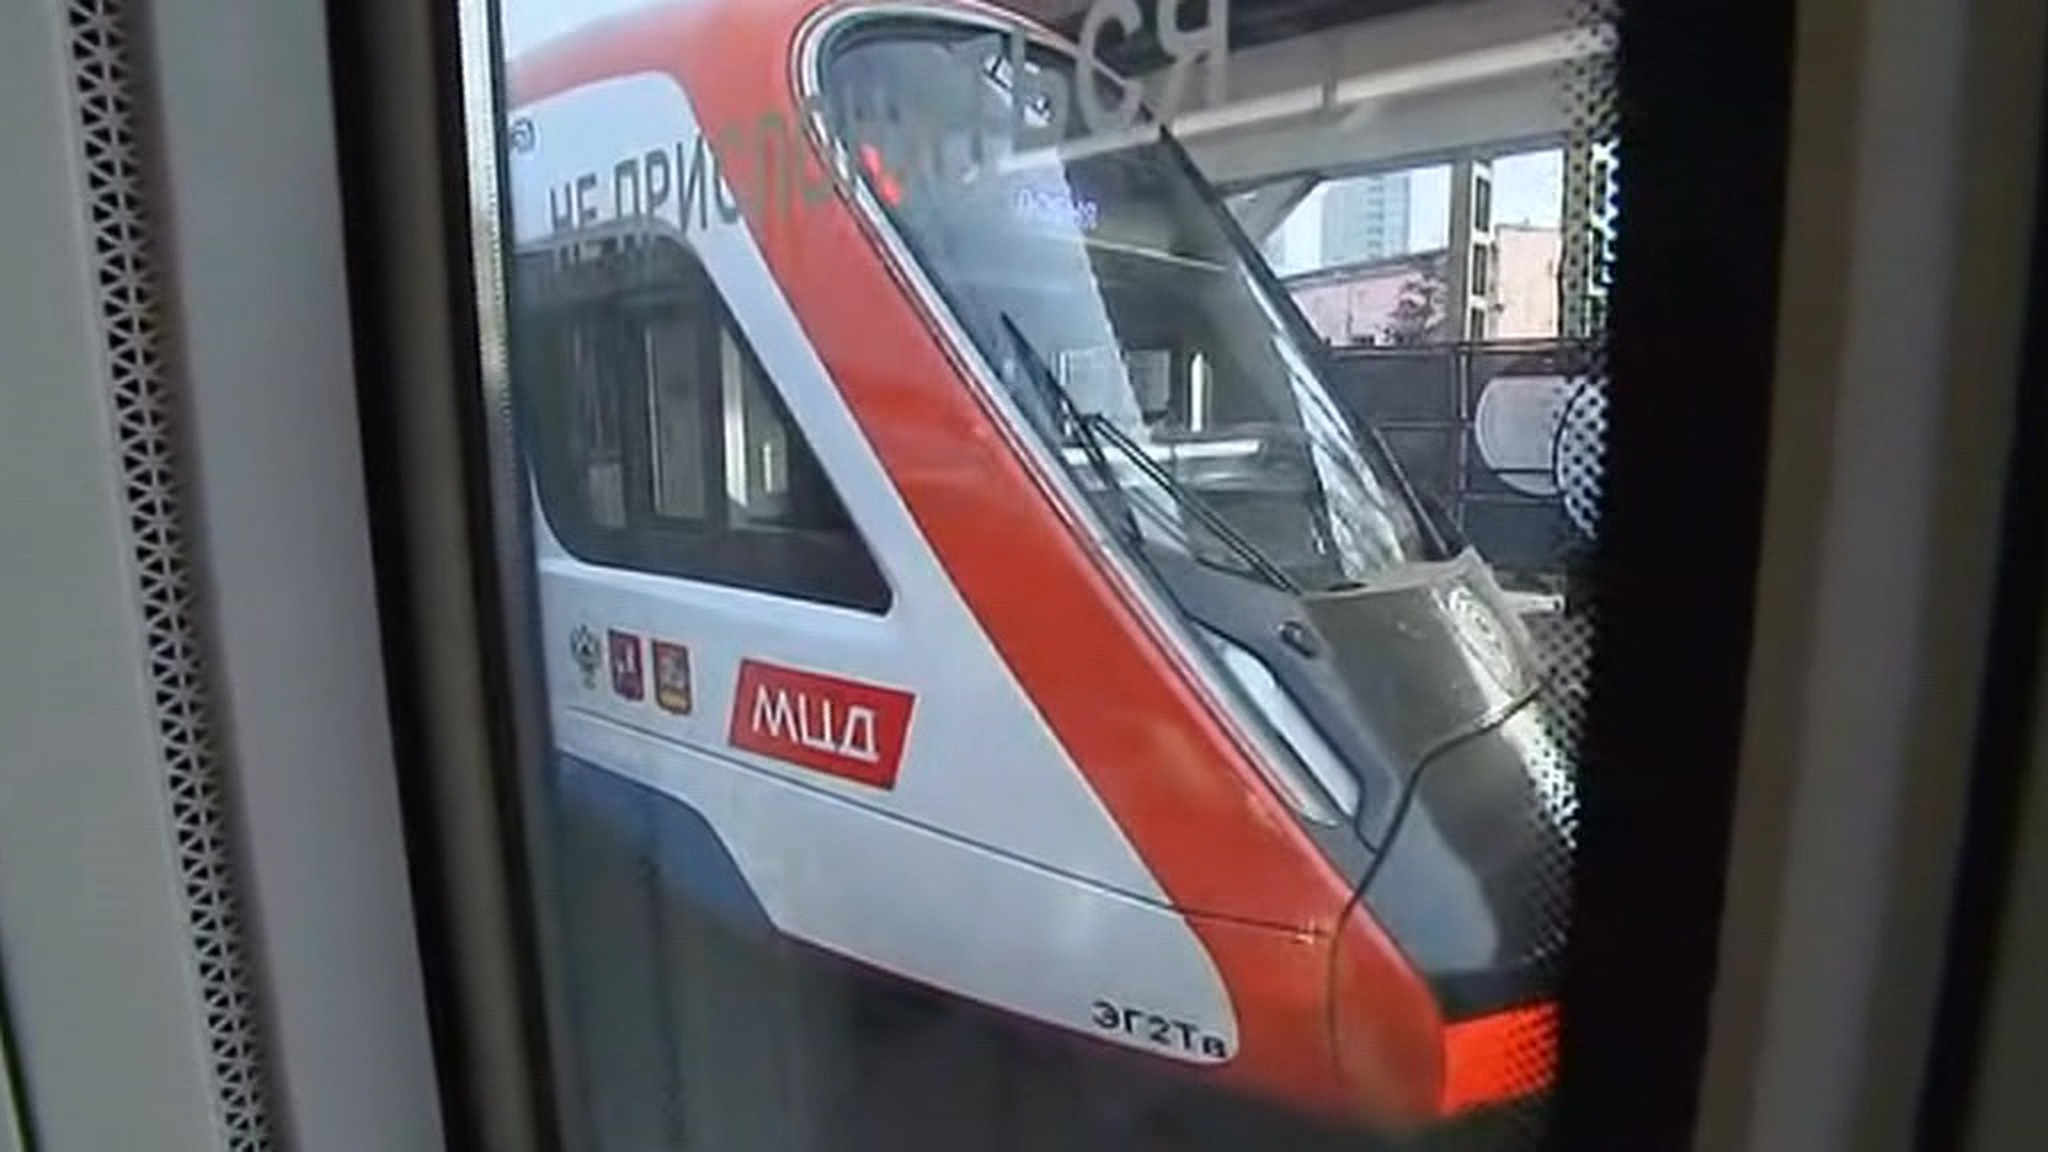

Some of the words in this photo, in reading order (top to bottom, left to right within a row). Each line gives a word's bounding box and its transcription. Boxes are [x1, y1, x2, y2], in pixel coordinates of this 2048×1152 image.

[549, 172, 601, 272] НЕ
[614, 0, 1228, 254] ПРИСЛОЬСЯ
[752, 684, 880, 763] МЦД
